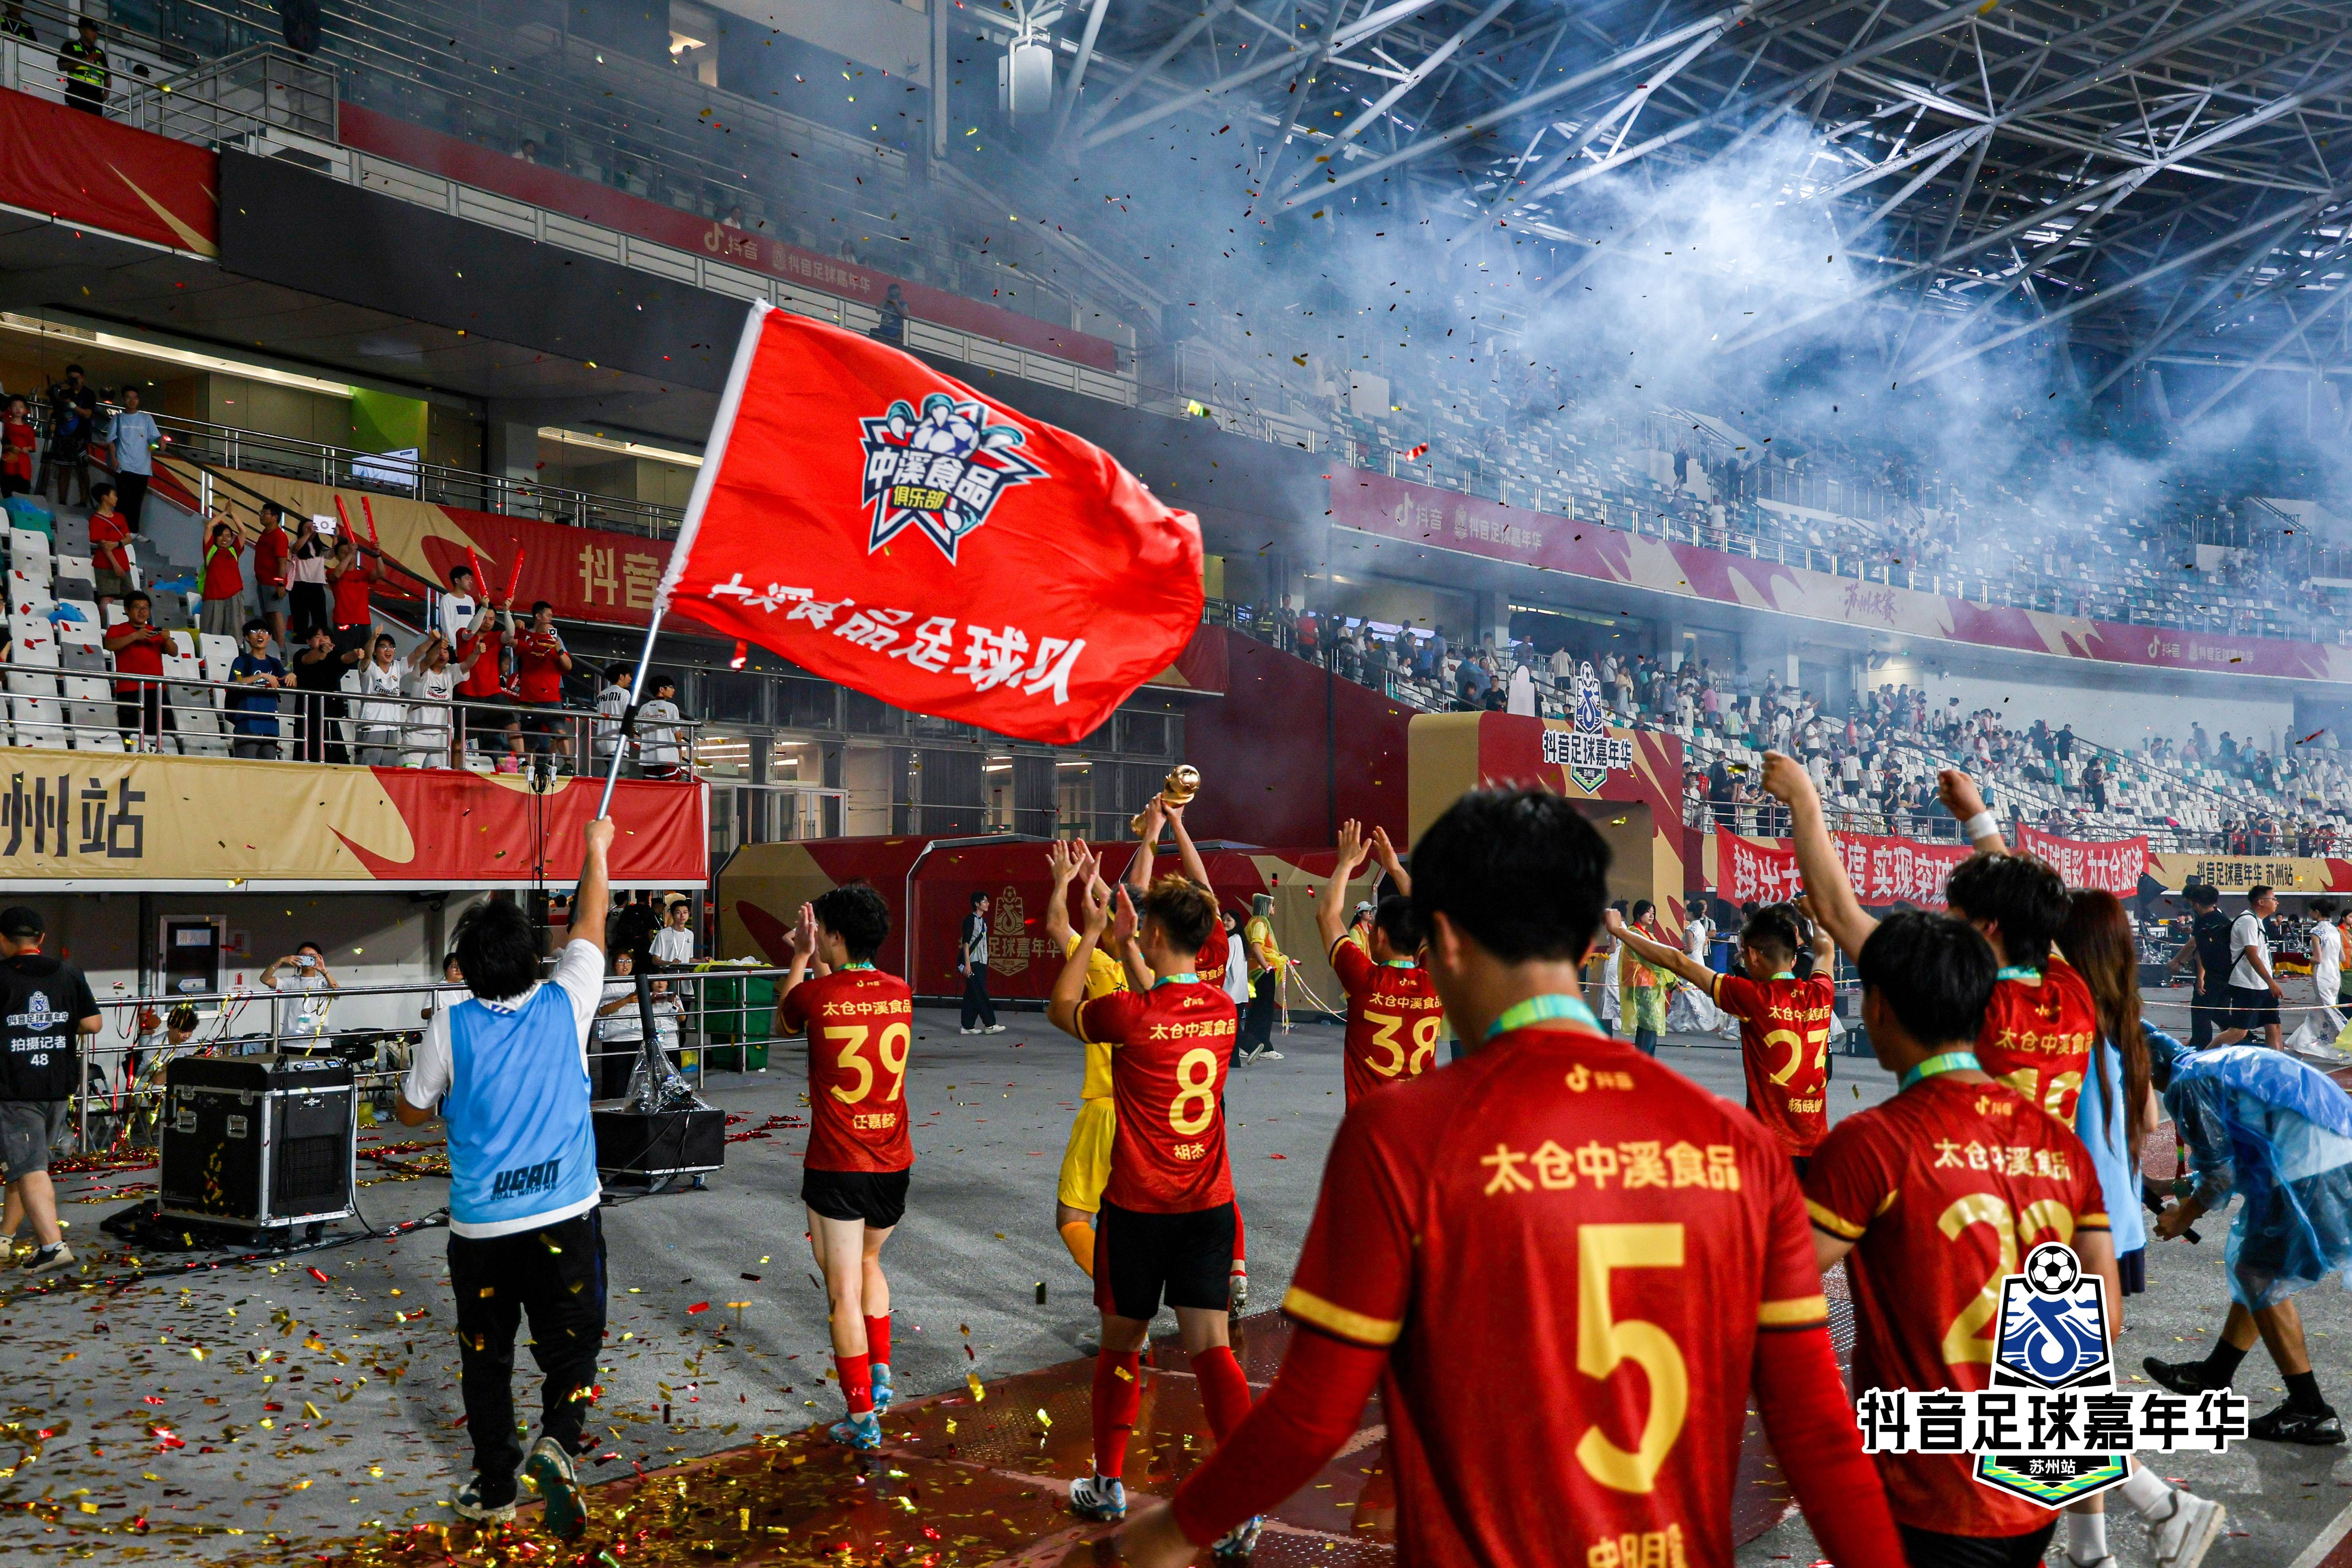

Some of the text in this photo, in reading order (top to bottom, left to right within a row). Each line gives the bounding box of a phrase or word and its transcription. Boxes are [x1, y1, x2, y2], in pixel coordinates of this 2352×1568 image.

[728, 234, 758, 260] 抖音
[789, 255, 870, 294] 抖音足球嘉年华
[868, 447, 1000, 511] 中溪食品
[894, 485, 947, 509] 俱乐部
[1416, 504, 1442, 531] 抖音
[1469, 518, 1542, 551] 抖音足球嘉年华
[579, 543, 660, 609] 抖音
[1544, 732, 1631, 768] 抖音足球嘉年华
[1, 771, 145, 858] 州站
[1872, 845, 1962, 905] 实现突破
[2197, 861, 2293, 886] 抖音足球嘉年华 苏州站
[958, 936, 1061, 958] 足球嘉年华
[1197, 965, 1224, 981] 溪食品
[823, 999, 911, 1016] 太仓中溪食品
[1369, 992, 1443, 1009] 太仓中溪食品
[1768, 1004, 1831, 1022] 太仓中溪食品
[8, 1012, 69, 1025] 抖音足球嘉年华
[1149, 1018, 1236, 1040] 太仓中溪食品
[11, 1035, 66, 1052] 拍摄记者
[1364, 1009, 1441, 1077] 38
[1995, 1027, 2093, 1055] 太仓中溪食品
[31, 1054, 49, 1065] 48
[824, 1022, 911, 1104] 39
[1763, 1027, 1829, 1094] 23
[1169, 1048, 1217, 1135] 8
[1174, 1142, 1206, 1160] 胡杰
[1933, 1137, 2071, 1181] 太仓中溪食品
[493, 1158, 562, 1193] UCAN
[1480, 1139, 1741, 1195] 太仓中溪食品
[518, 1185, 541, 1197] WITH
[544, 1182, 557, 1191] ME
[1938, 1193, 2073, 1364] 2
[1575, 1222, 1688, 1495] 5
